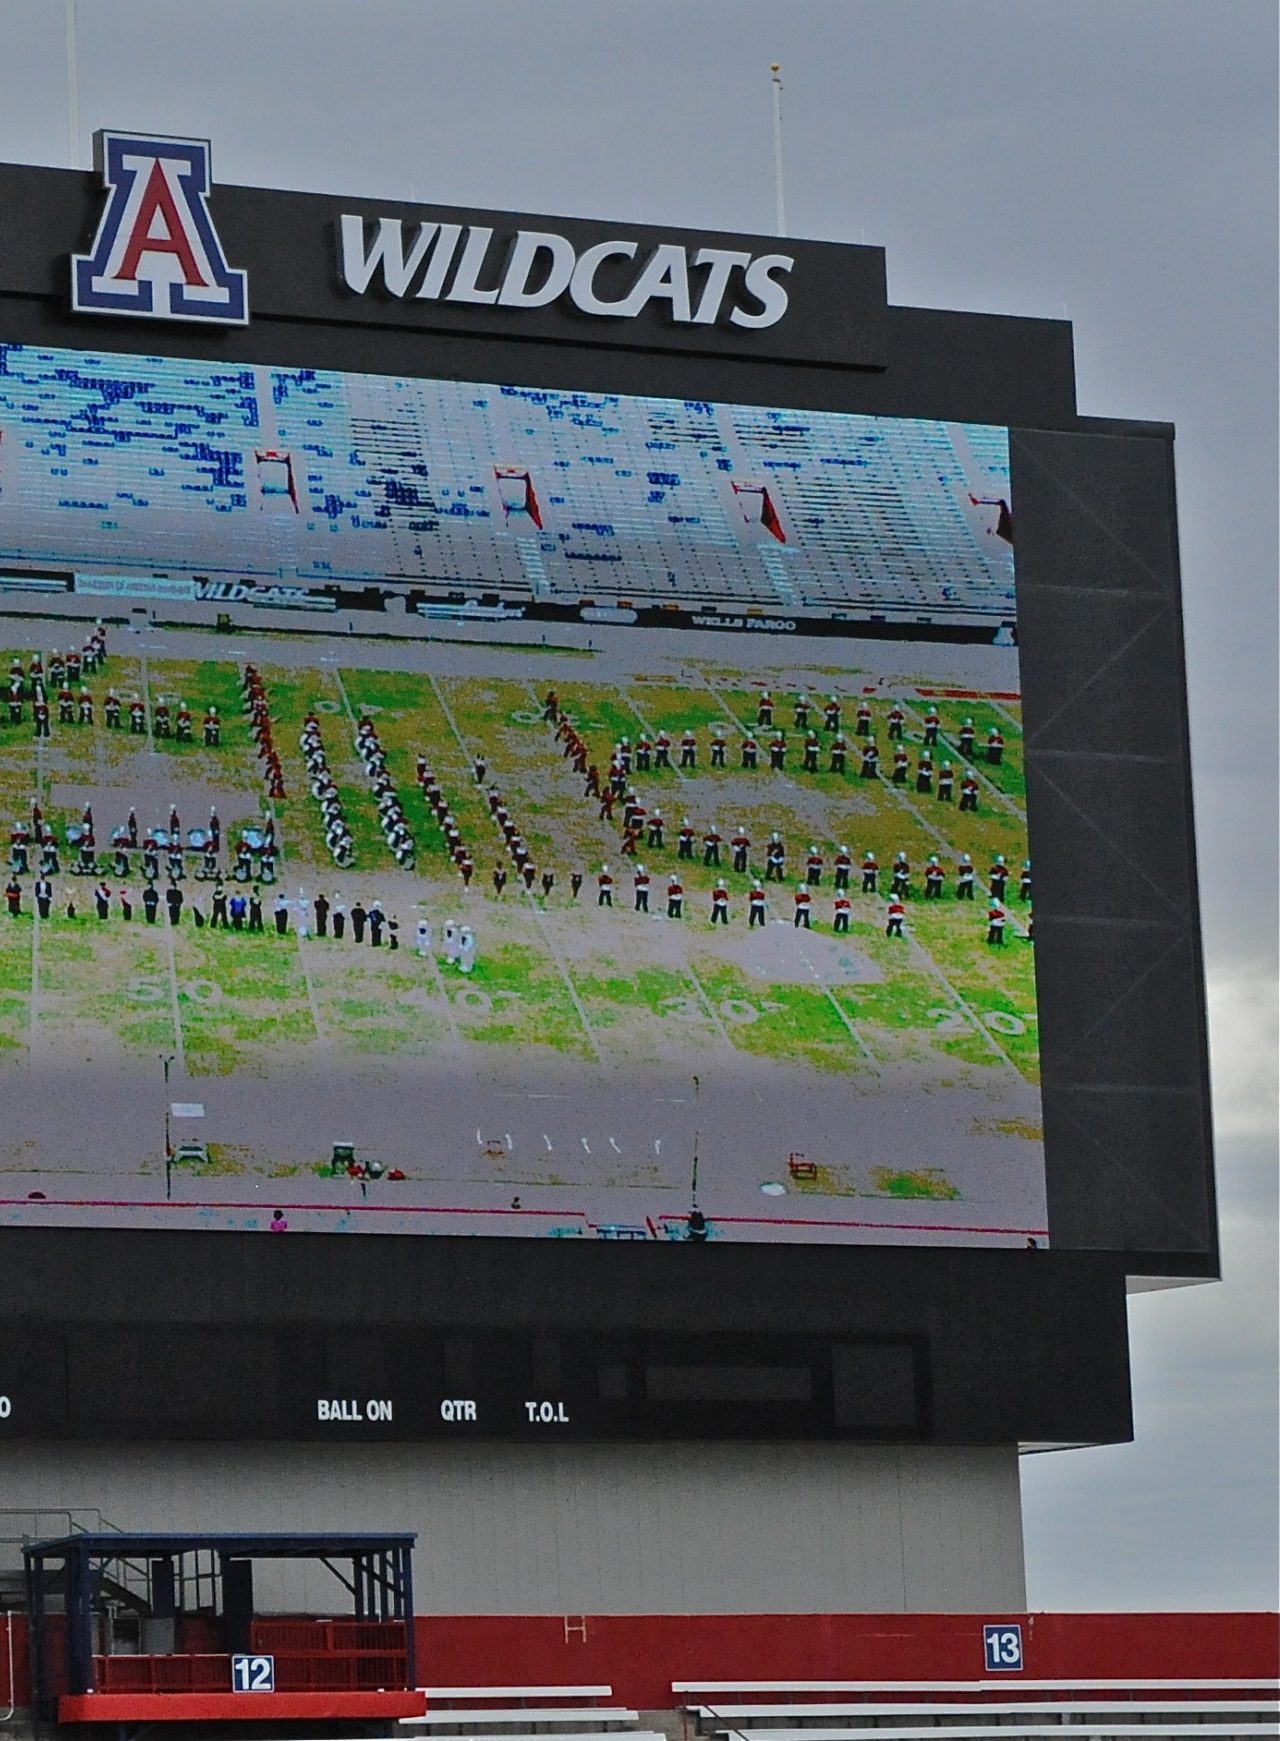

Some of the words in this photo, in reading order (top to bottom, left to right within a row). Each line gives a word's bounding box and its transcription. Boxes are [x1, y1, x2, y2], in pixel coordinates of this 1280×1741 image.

[70, 129, 251, 327] A
[340, 213, 795, 330] WILDCATS
[317, 1400, 363, 1421] BALL
[366, 1400, 393, 1421] ON
[440, 1400, 477, 1422] QTR
[525, 1402, 569, 1422] T.O.L
[986, 1632, 1020, 1664] 13
[235, 1658, 272, 1690] 12
